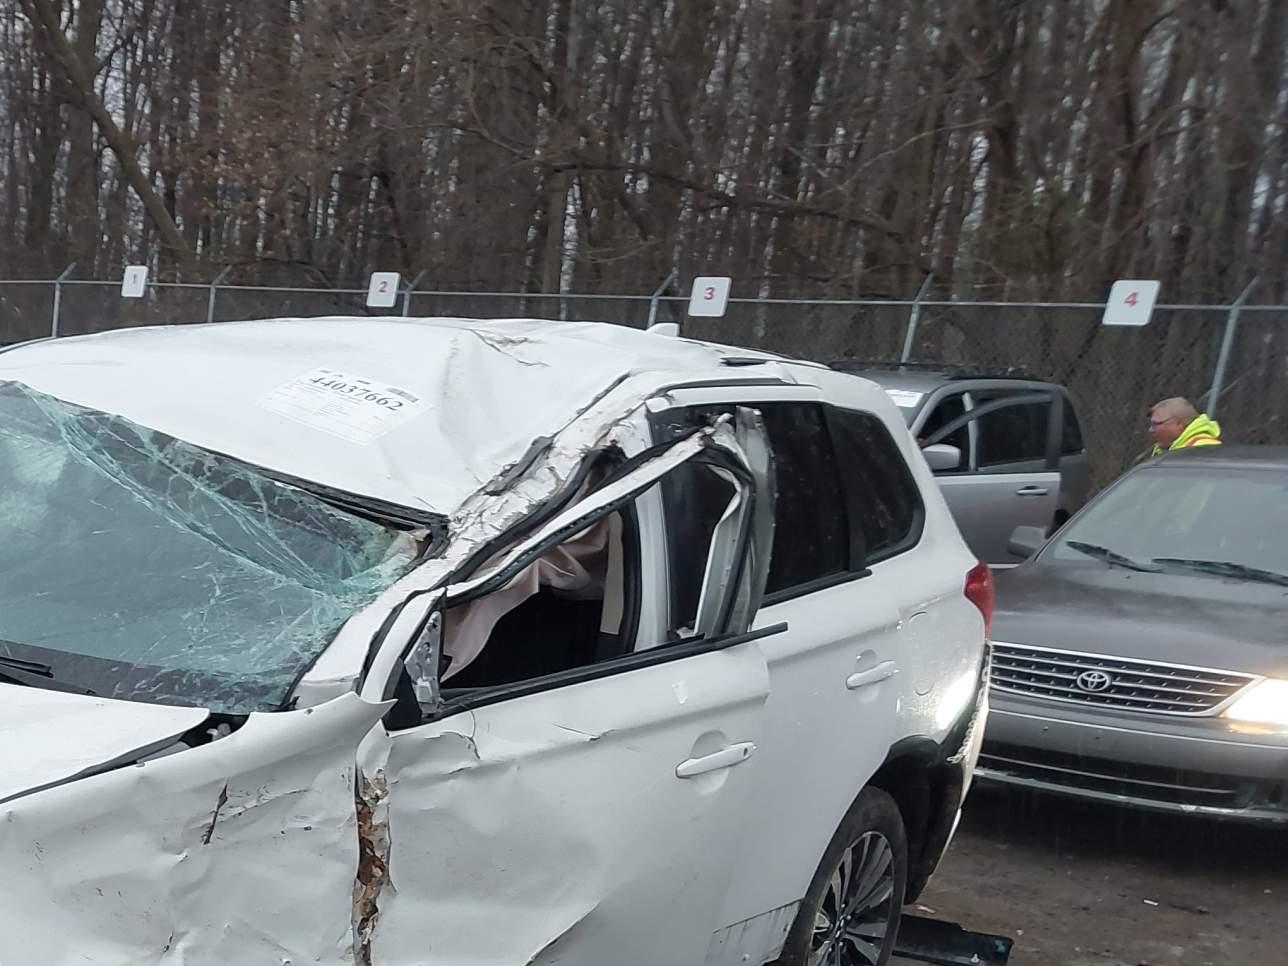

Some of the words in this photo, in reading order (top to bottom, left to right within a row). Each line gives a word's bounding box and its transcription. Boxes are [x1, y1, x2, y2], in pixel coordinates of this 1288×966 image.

[378, 281, 388, 293] 2
[703, 286, 715, 300] 3
[1123, 291, 1138, 307] 4
[309, 377, 404, 411] 44037662
